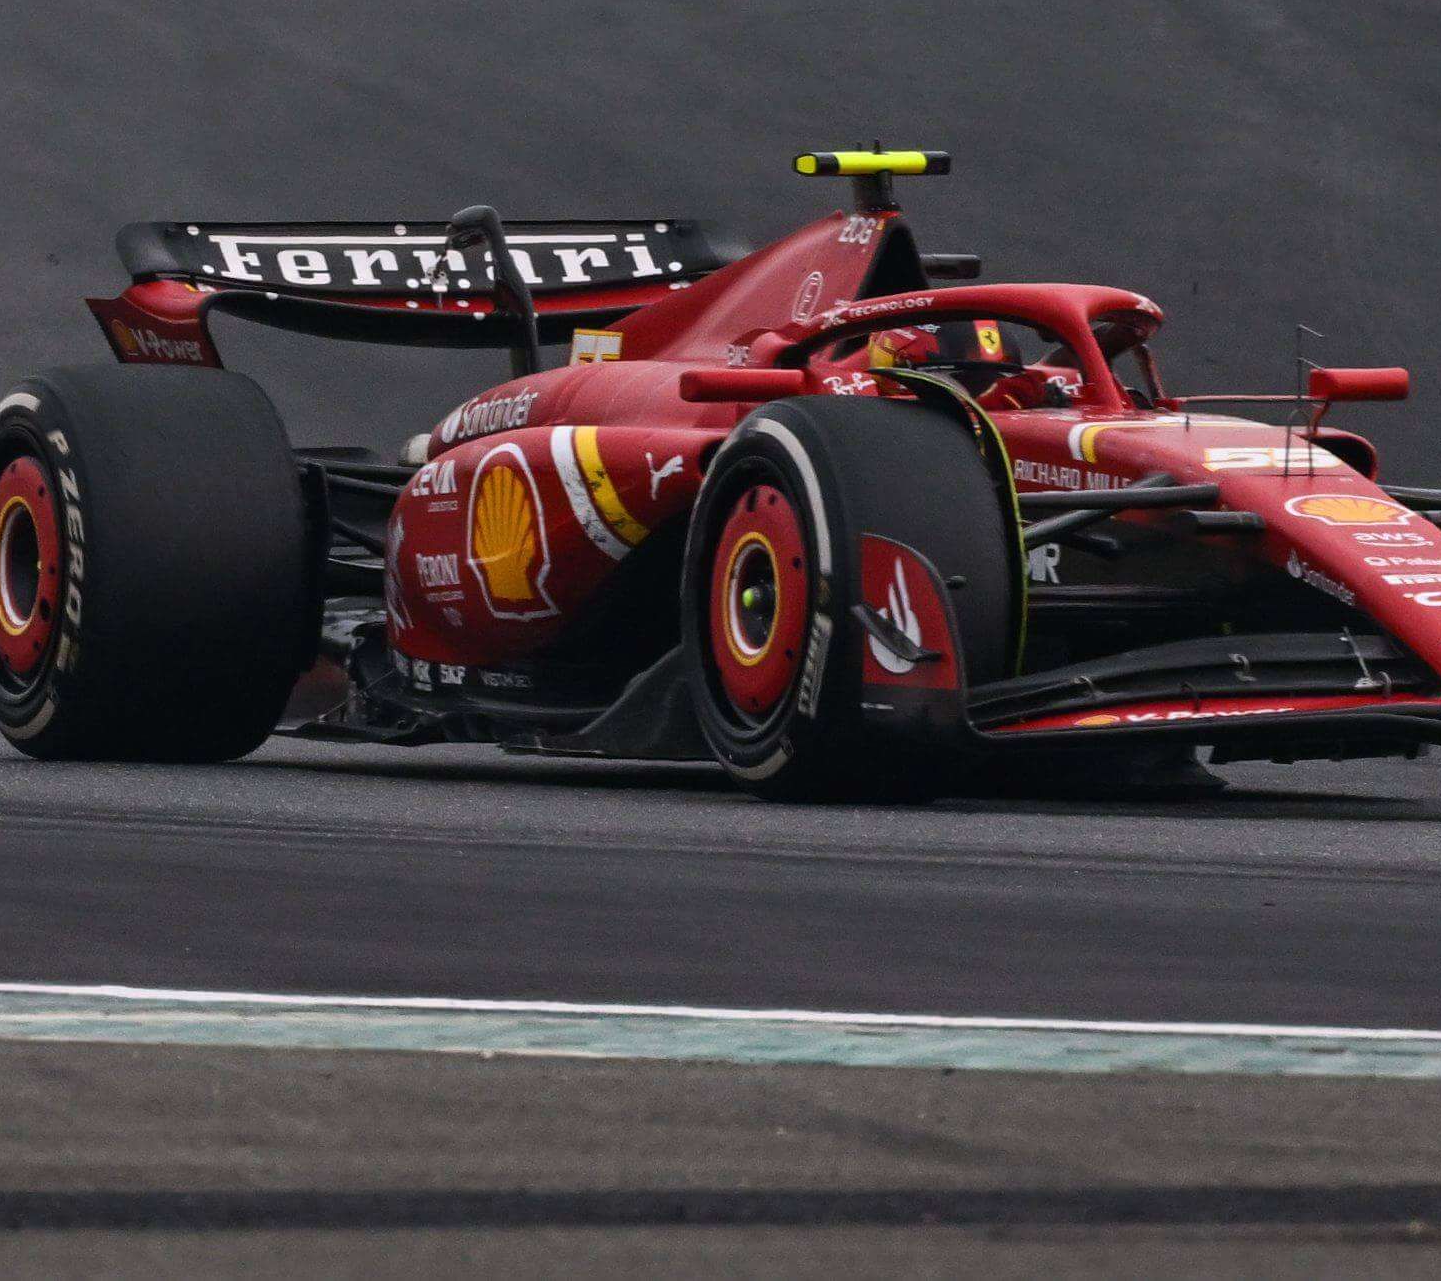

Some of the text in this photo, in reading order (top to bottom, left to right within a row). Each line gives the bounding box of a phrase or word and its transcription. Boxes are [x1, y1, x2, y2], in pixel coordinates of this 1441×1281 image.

[849, 296, 935, 318] TECHNOLOGY
[1014, 459, 1081, 490] RICHARD
[1352, 531, 1425, 543] aws
